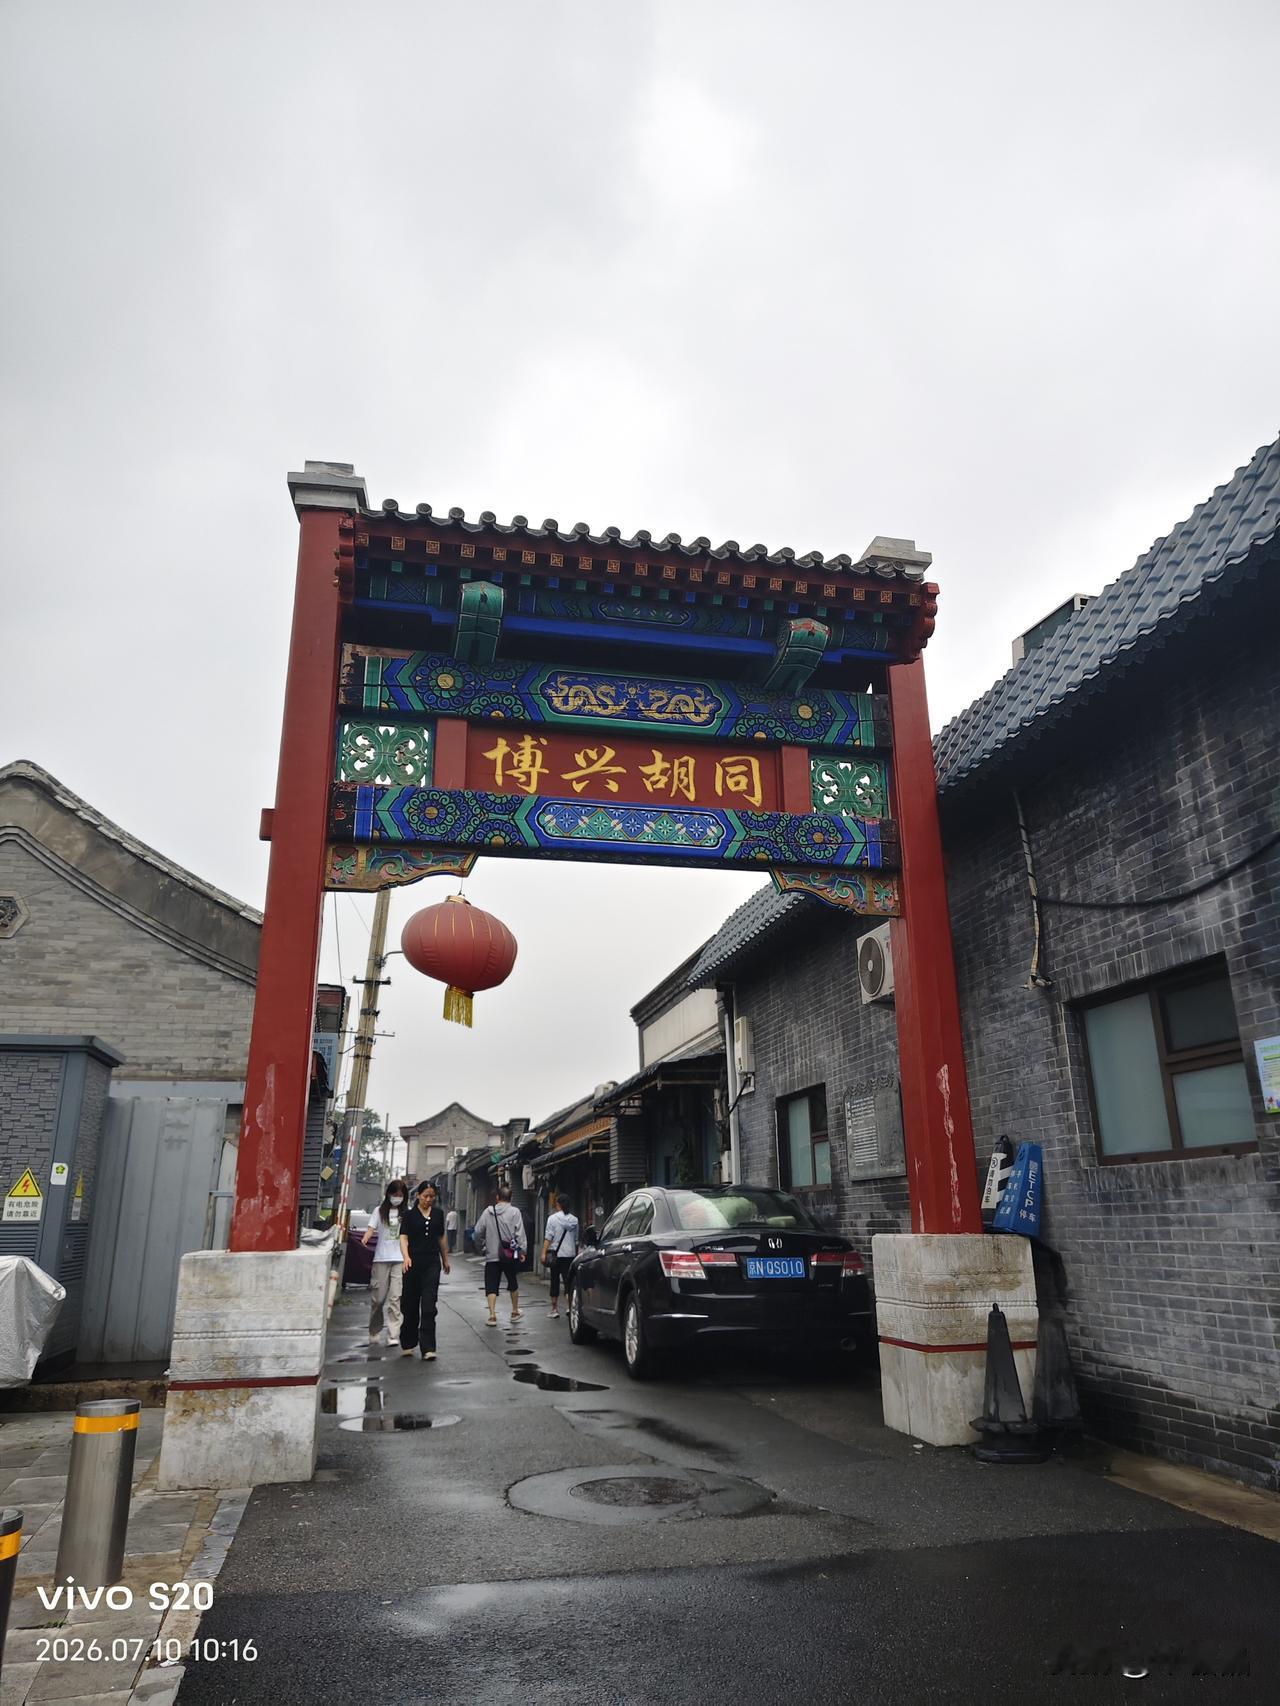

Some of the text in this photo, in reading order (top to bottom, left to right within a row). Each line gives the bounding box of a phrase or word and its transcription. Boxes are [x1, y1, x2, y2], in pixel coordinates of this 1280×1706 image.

[482, 734, 763, 807] 博兴胡同
[1019, 1208, 1037, 1223] 停车
